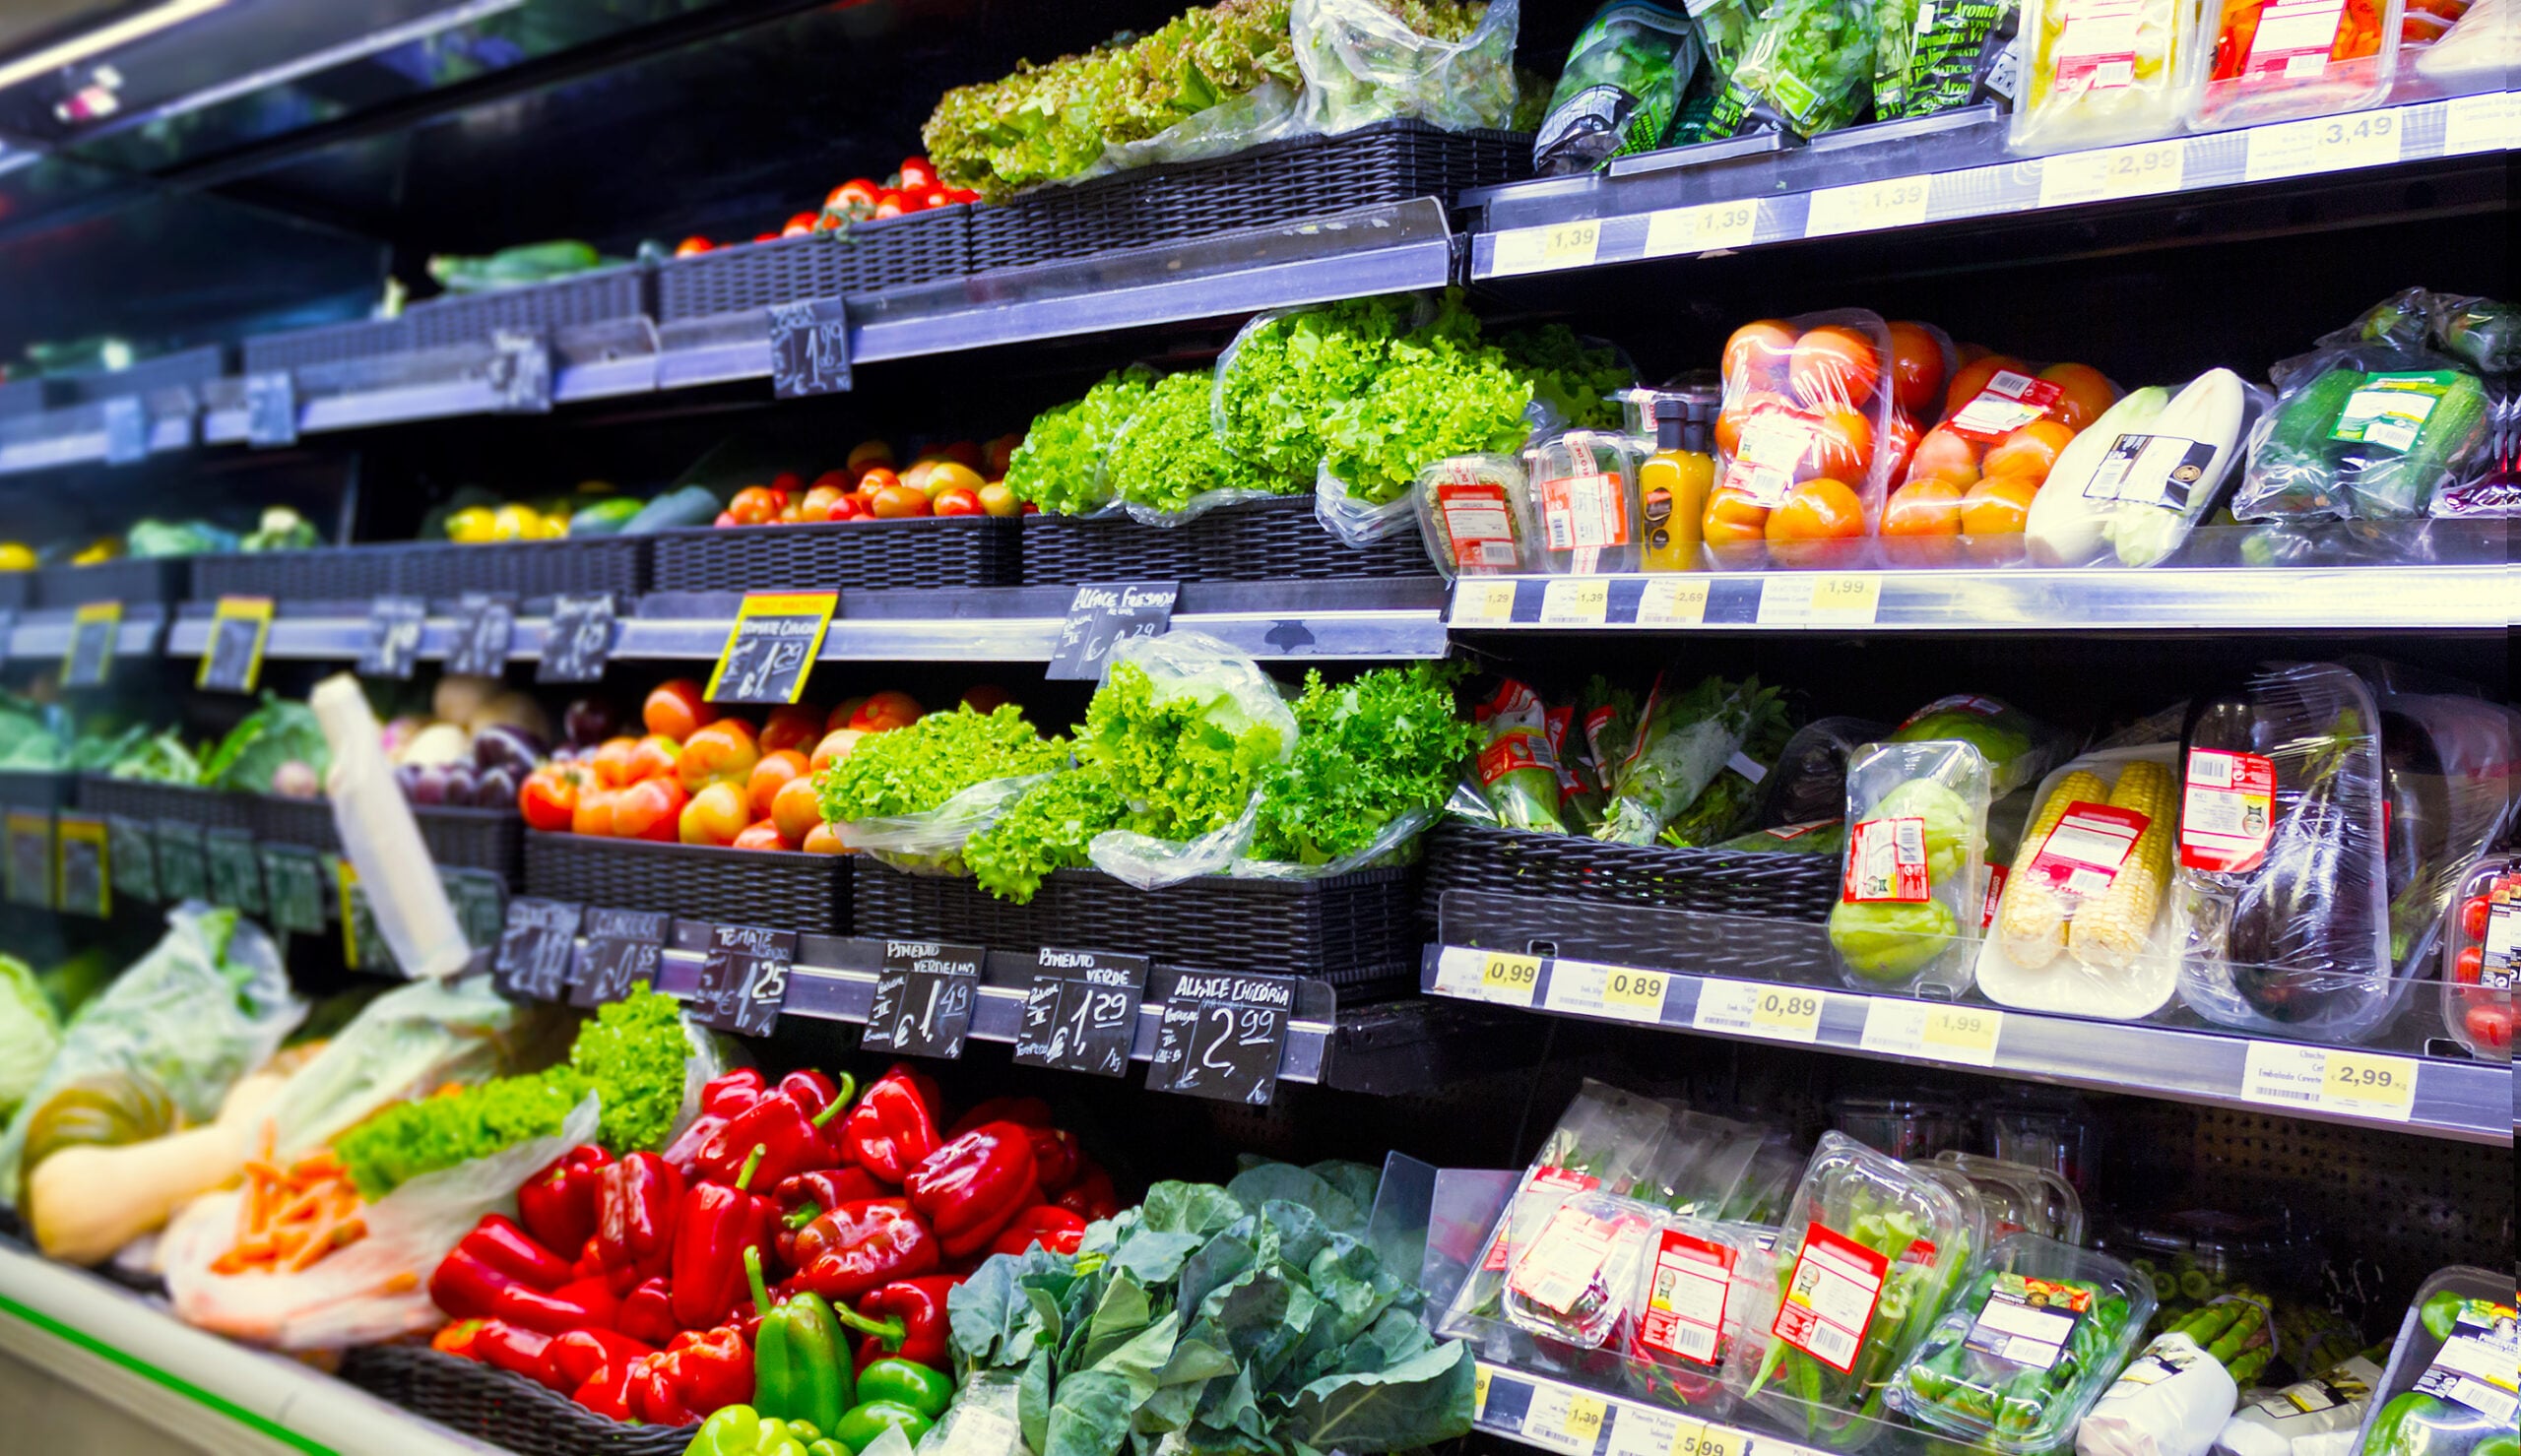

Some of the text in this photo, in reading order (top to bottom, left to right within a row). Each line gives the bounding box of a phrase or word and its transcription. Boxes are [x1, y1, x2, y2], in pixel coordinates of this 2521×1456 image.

[2324, 115, 2393, 145] 3,49
[2118, 150, 2176, 177] 2,99
[1873, 186, 1921, 210] 1,39
[1702, 209, 1749, 231] 1,39
[1553, 229, 1594, 250] 1,39
[1580, 593, 1604, 604] 1,39
[1678, 592, 1704, 603] 2,69
[1828, 580, 1864, 596] 1,99
[1487, 594, 1510, 605] 1,29
[715, 927, 774, 947] TOMATE
[1039, 947, 1095, 968] PIMENTO
[1086, 969, 1131, 986] VERDE
[1491, 962, 1536, 984] 0,99
[1174, 975, 1231, 998] ALFACE
[1614, 975, 1661, 998] 0,89
[1764, 994, 1817, 1016] 0,89
[1942, 1014, 1981, 1033] 1,99
[2339, 1066, 2393, 1088] 2,99
[1573, 1408, 1599, 1425] 1,39
